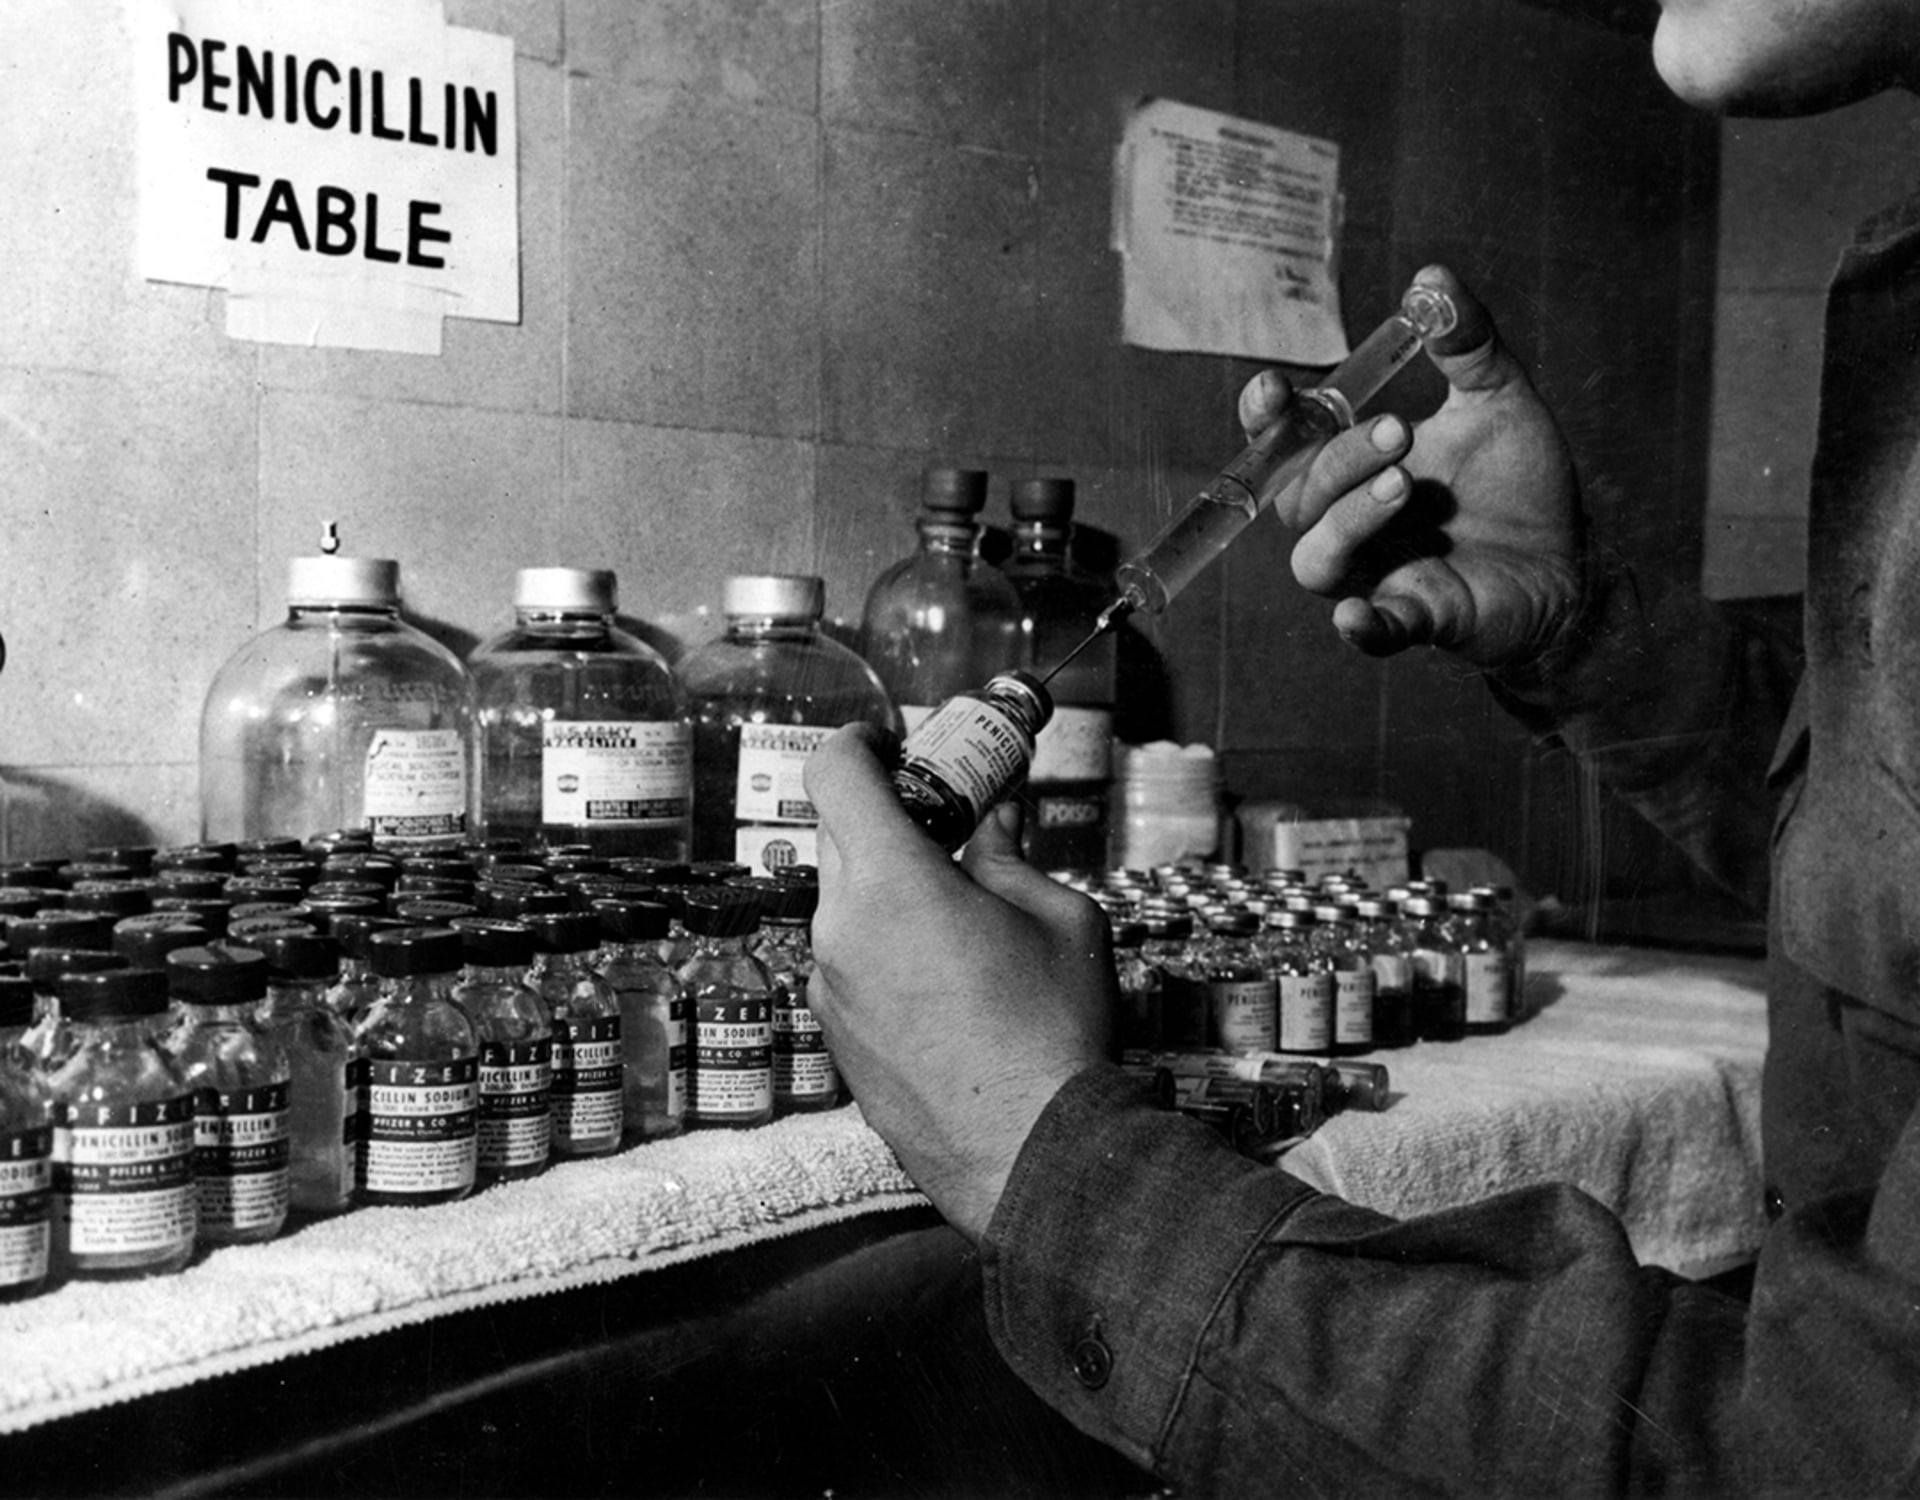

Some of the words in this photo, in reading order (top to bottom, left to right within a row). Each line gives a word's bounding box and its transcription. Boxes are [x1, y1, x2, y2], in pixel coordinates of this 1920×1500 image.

[168, 32, 497, 156] PENICILLIN
[207, 167, 451, 269] TABLE
[974, 713, 1022, 768] PENICILL
[1046, 803, 1098, 822] POISO
[724, 1027, 765, 1038] SODIUM
[373, 1091, 416, 1103] CILLIN
[373, 1118, 411, 1127] PFIZER
[72, 1132, 159, 1149] PENICILLIN
[0, 1161, 43, 1181] ODIUM
